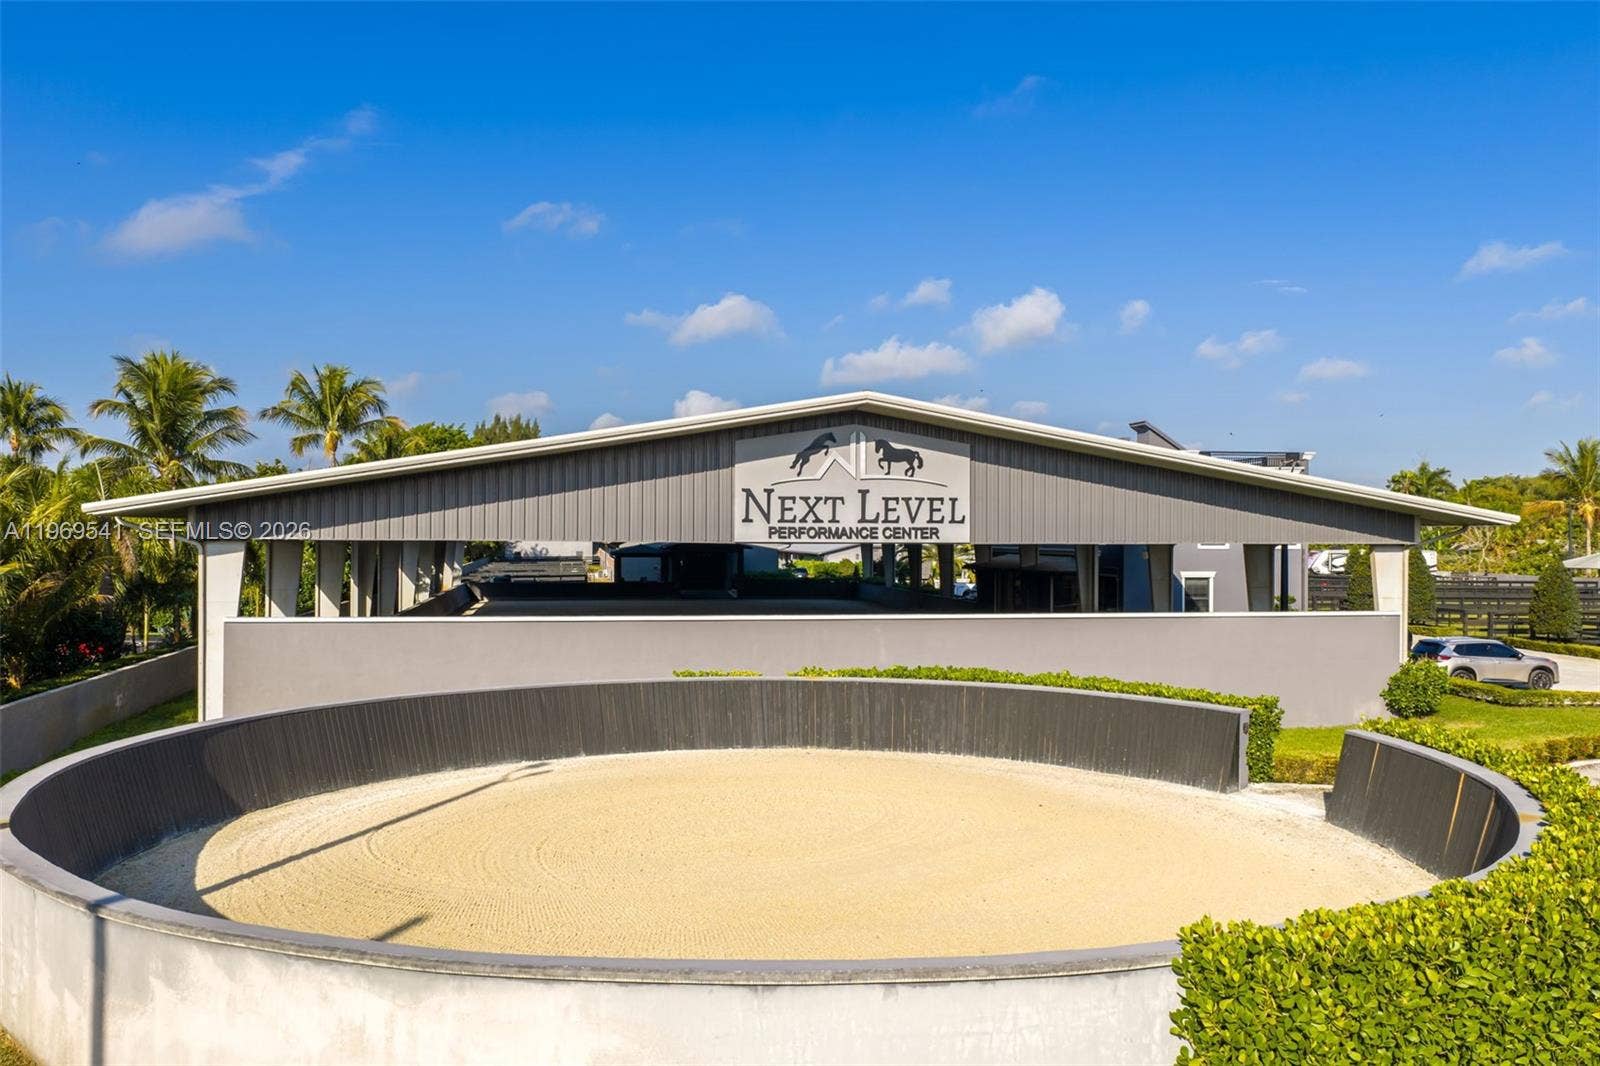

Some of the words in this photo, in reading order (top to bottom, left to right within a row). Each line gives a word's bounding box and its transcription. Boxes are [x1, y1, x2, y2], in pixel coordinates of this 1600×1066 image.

[741, 488, 845, 524] NEXT
[857, 489, 966, 524] LEVEL
[768, 526, 879, 540] PERFORMANCE
[882, 526, 940, 540] CENTER
